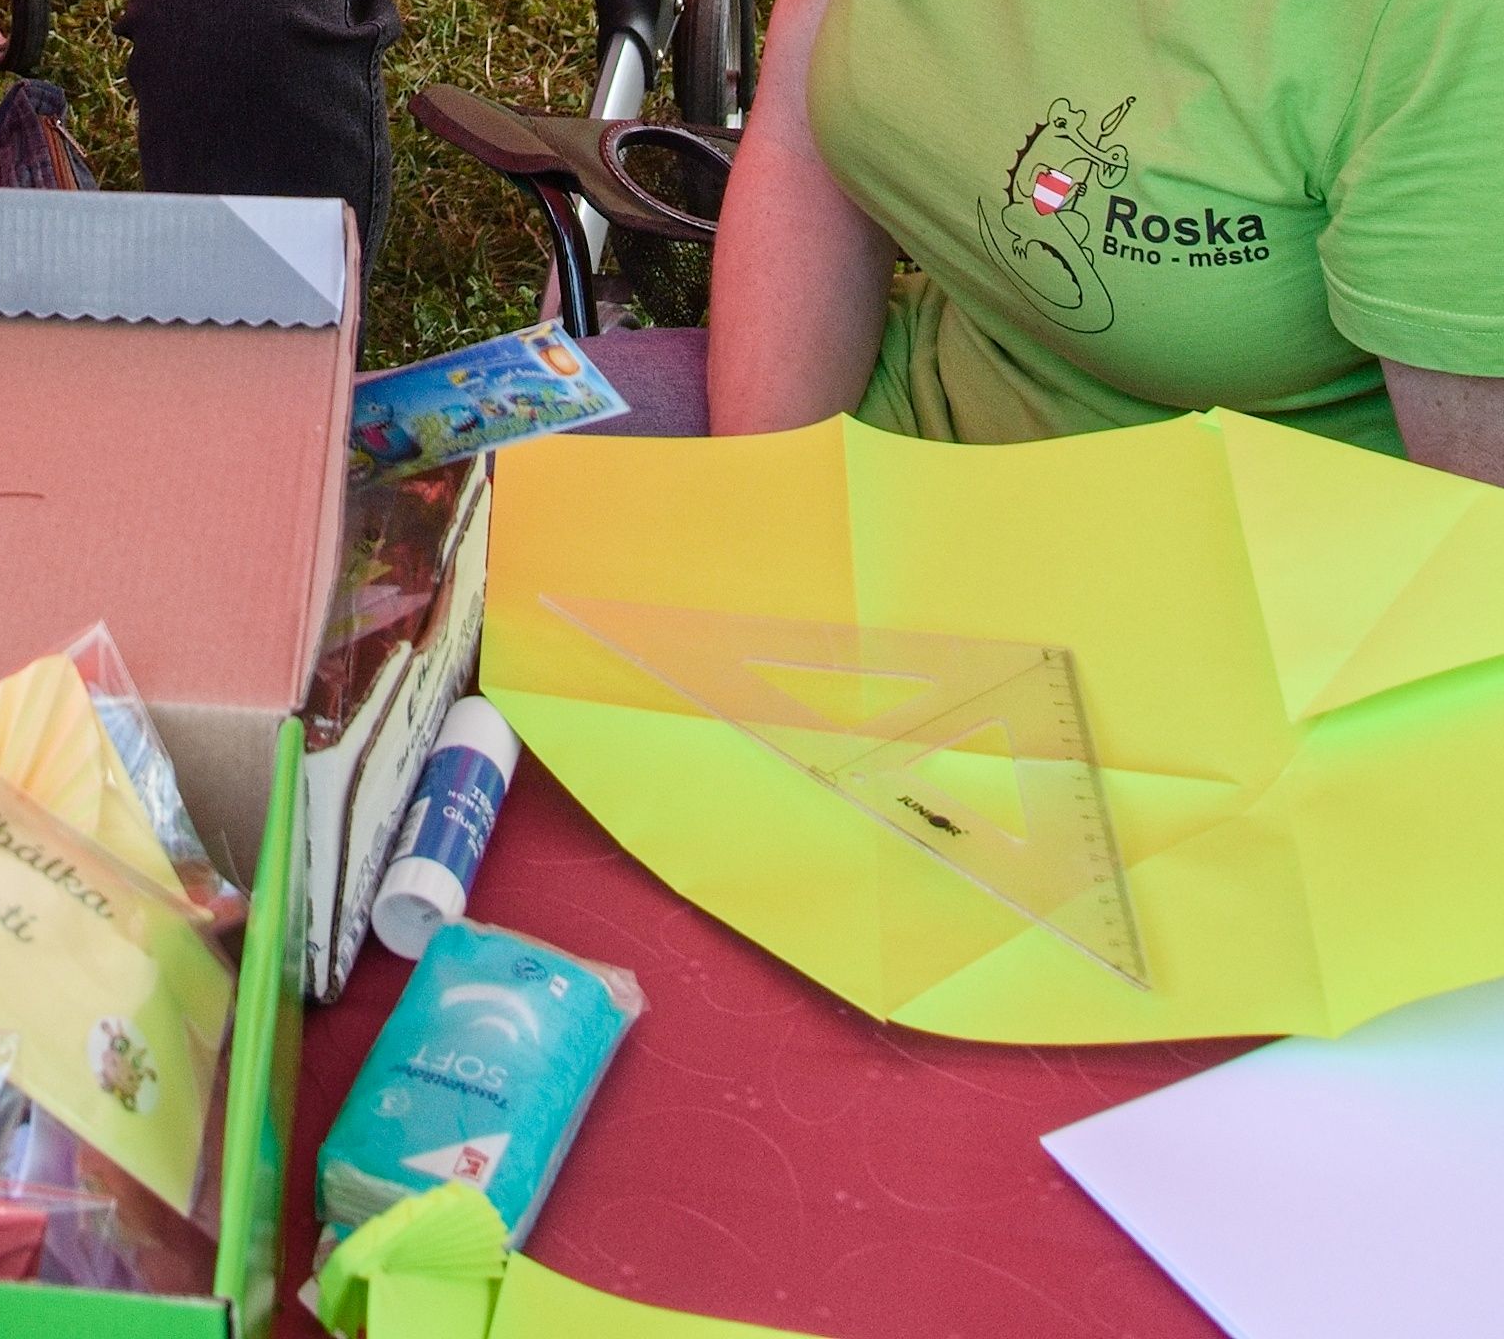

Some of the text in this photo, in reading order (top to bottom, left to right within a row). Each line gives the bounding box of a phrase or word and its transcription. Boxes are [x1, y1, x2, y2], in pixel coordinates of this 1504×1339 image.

[1105, 195, 1267, 245] Roska
[1102, 234, 1161, 265] Brno
[1188, 244, 1270, 268] město
[443, 805, 481, 838] Glue
[896, 795, 962, 837] JUNIOR
[405, 1041, 511, 1091] SOFT
